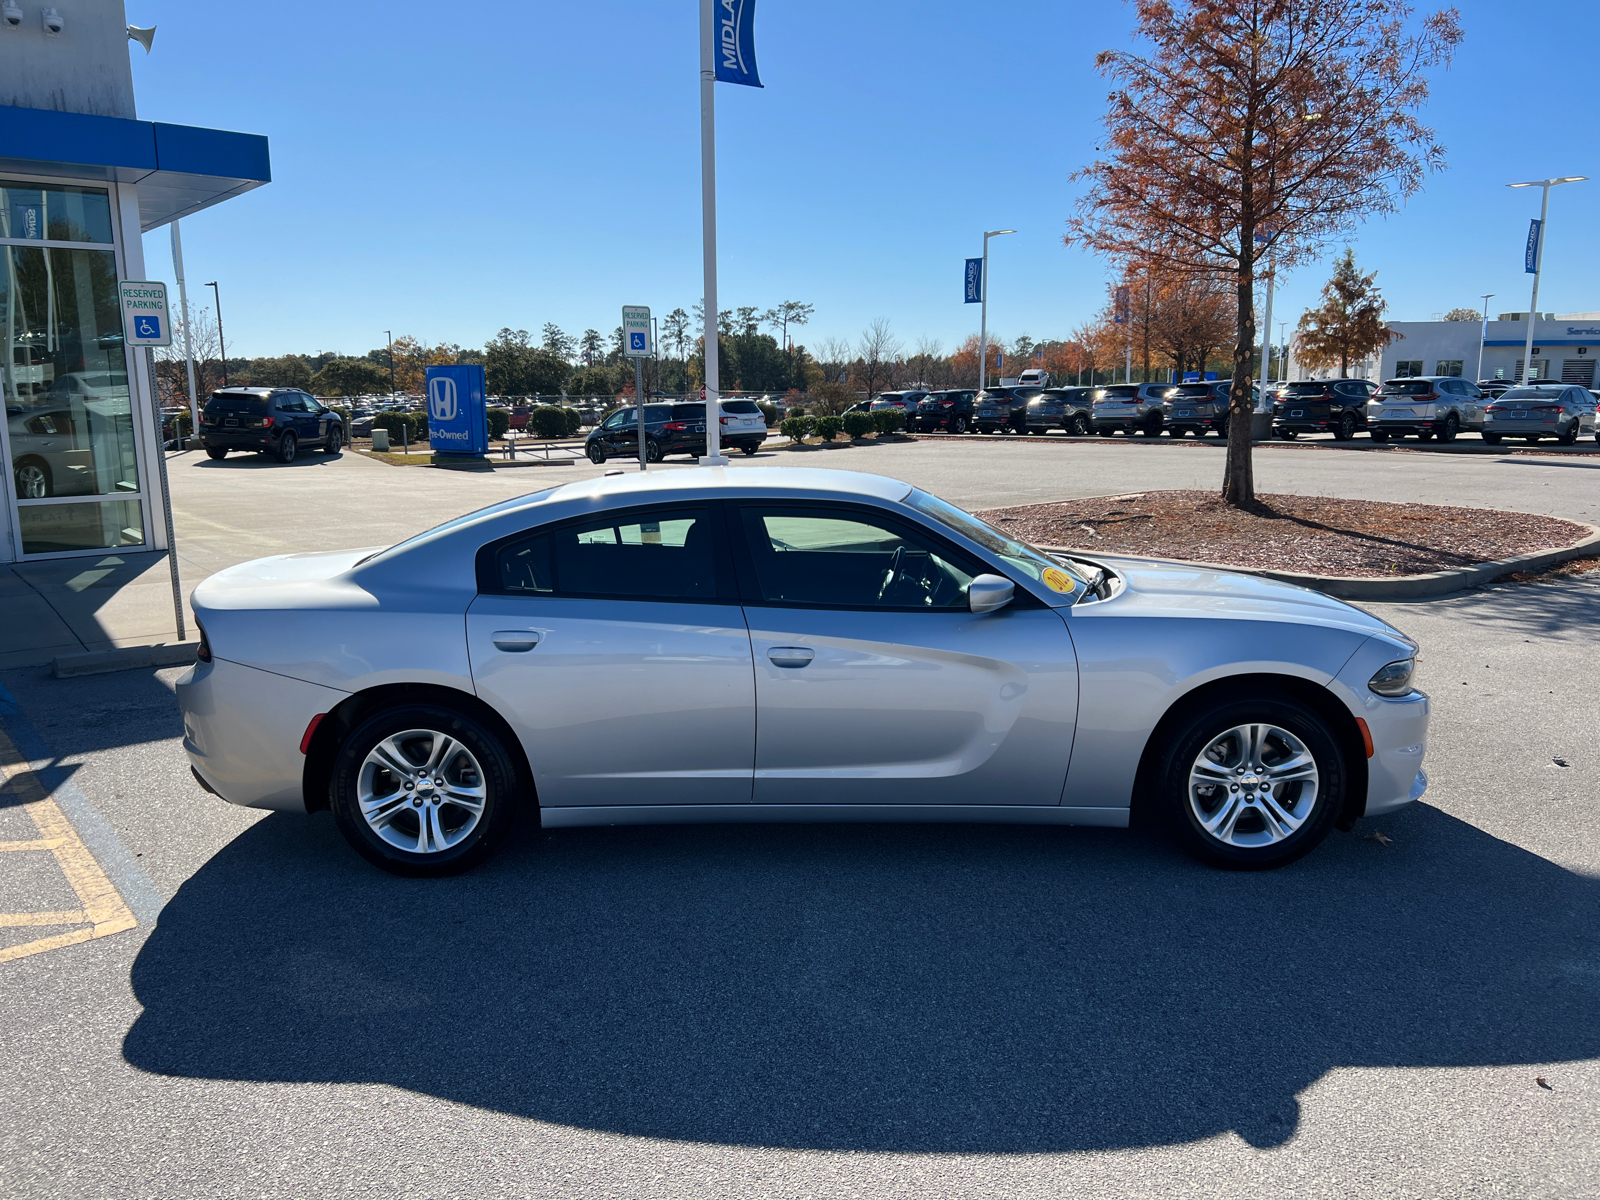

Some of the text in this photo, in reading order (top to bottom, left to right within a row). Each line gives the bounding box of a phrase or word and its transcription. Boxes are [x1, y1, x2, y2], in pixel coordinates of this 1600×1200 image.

[123, 289, 163, 298] RESERVED
[127, 301, 162, 309] PARKING
[428, 428, 469, 440] Pre-Owned
